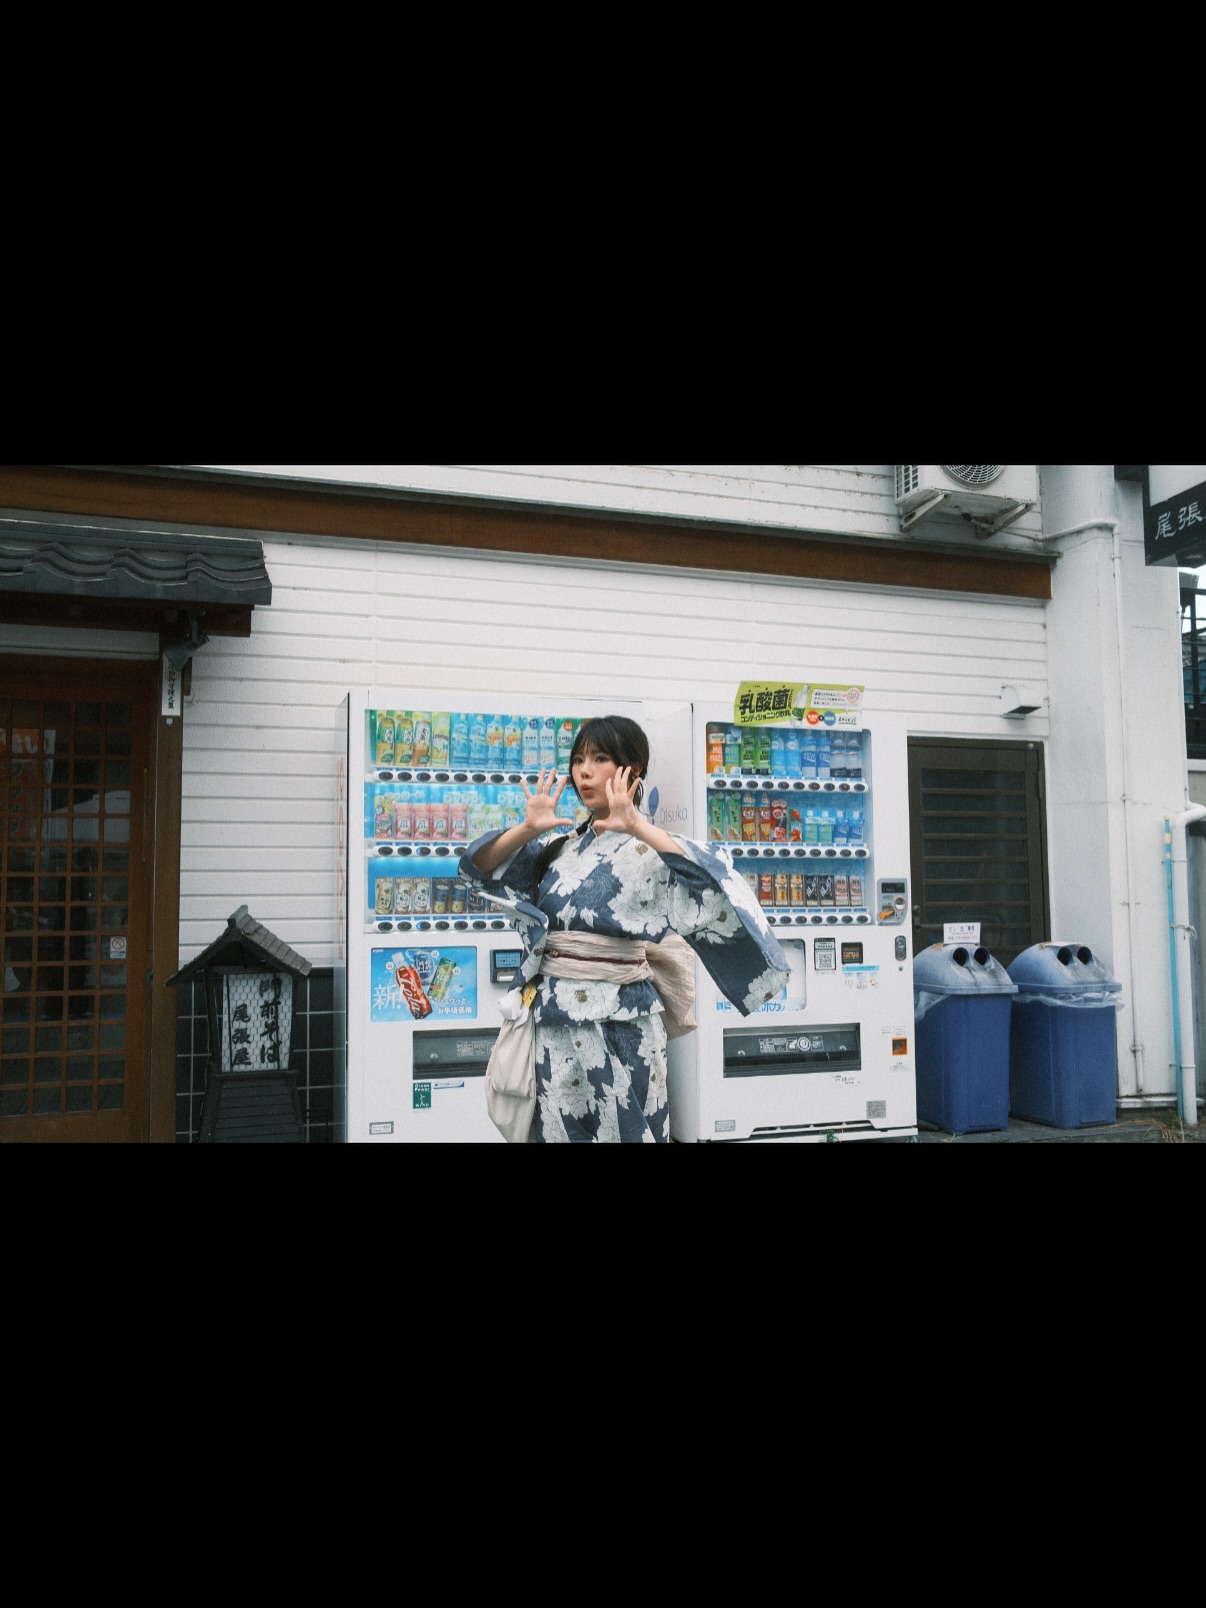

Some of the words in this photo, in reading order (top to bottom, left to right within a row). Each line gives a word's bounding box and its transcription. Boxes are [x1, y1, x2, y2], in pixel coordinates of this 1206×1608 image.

[1155, 501, 1206, 541] 尾張
[739, 689, 790, 715] 乳酸菌
[660, 804, 688, 824] Otsuka
[231, 1003, 252, 1066] 尾張屋
[259, 978, 282, 1064] 門前そば
